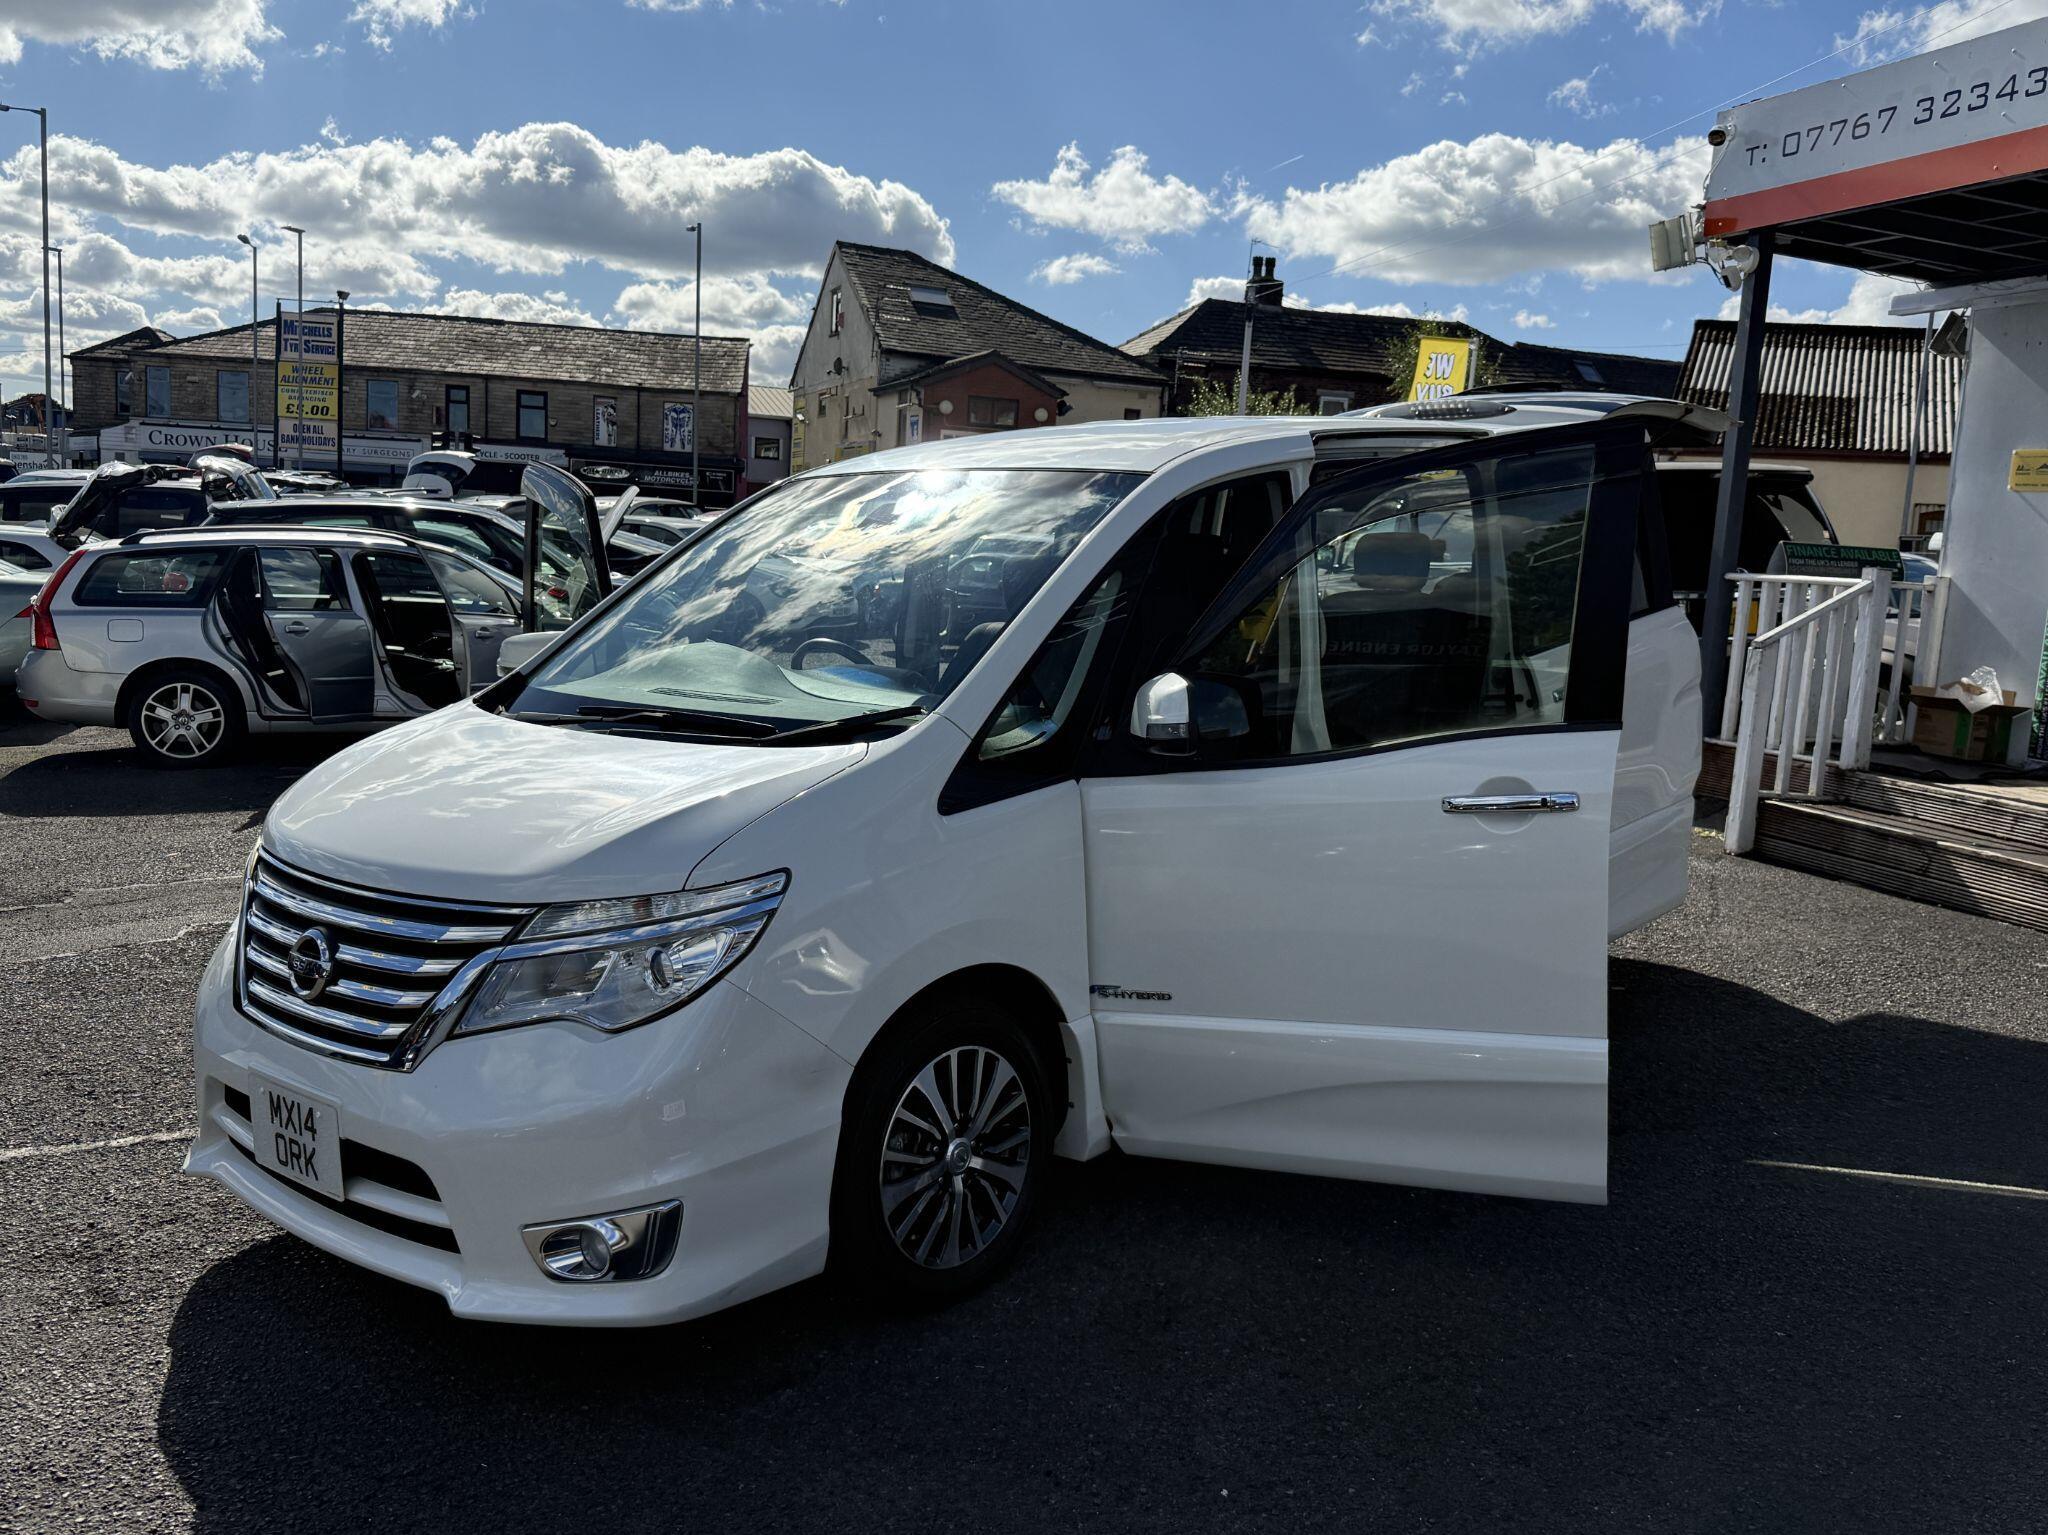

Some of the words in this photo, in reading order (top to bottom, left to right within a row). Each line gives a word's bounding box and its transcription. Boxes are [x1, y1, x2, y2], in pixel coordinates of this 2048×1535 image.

[1746, 144, 1767, 166] T:
[1782, 105, 1897, 158] 07767
[1914, 66, 2048, 125] 32343
[283, 319, 333, 338] MICHELLS
[283, 338, 300, 353] TYR
[303, 340, 336, 356] SERVICE
[292, 365, 326, 376] WHEEL
[292, 423, 312, 435] OEN
[312, 424, 325, 436] ALL
[148, 429, 217, 447] CROWN
[223, 433, 288, 453] HOUS
[280, 433, 300, 445] BANK
[301, 435, 336, 448] HOLIDAYS
[362, 447, 412, 458] SURGEONS
[504, 452, 541, 462] SCOOTER
[14, 460, 48, 470] ensha
[1787, 544, 1839, 559] FINANCE
[1840, 548, 1900, 562] AVAILABLE
[268, 1090, 317, 1142] MX14
[275, 1131, 319, 1181] ORK
